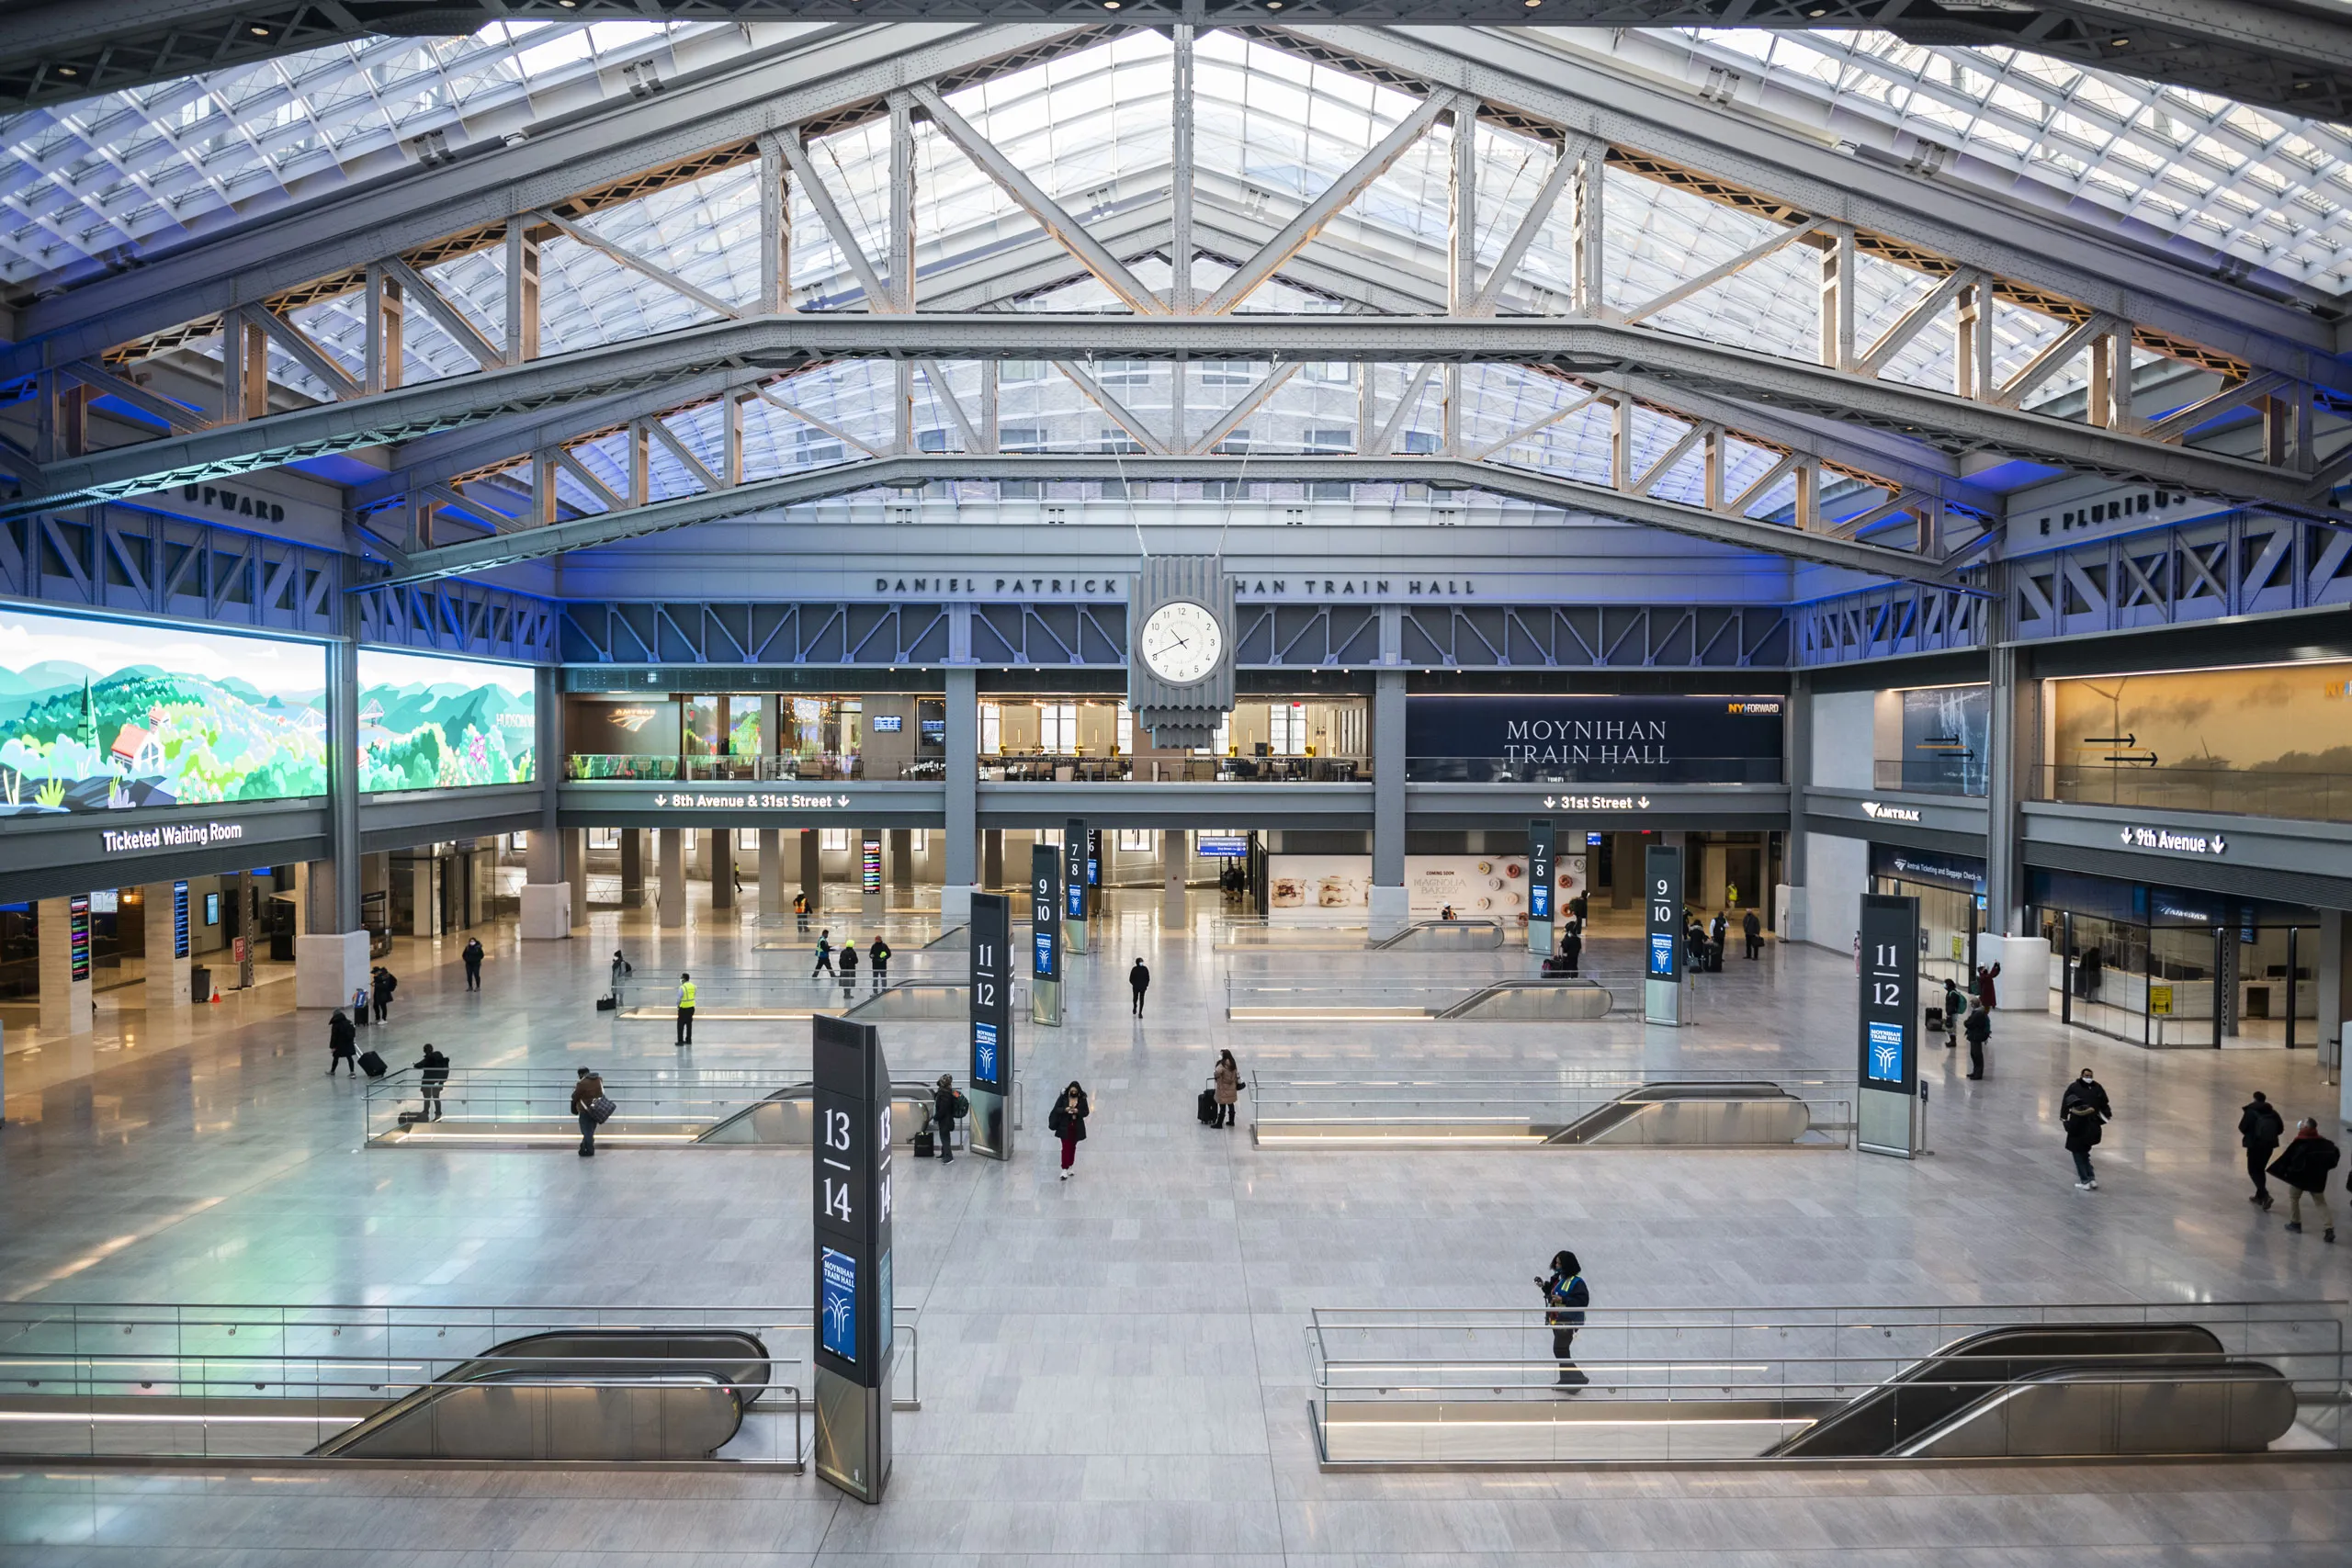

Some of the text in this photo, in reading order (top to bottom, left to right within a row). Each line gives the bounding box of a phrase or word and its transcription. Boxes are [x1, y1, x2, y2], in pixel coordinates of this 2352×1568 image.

[185, 483, 284, 522] UPWARD
[2040, 518, 2050, 535] E
[876, 579, 975, 592] DANIEL
[996, 579, 1115, 593] PATRICK
[1305, 581, 1389, 594] TRAIN
[1409, 581, 1474, 594] HALL
[1728, 704, 1779, 713] NY FORWARD
[1507, 720, 1666, 739] MOYNIHAN
[1504, 745, 1670, 764] TRAIN HALL
[673, 794, 831, 807] 8th Avenue & 31st Street
[1561, 796, 1632, 809] 31st Street
[1876, 808, 1919, 821] AMTRAK
[103, 823, 242, 852] Ticketed Waiting Room
[2137, 829, 2206, 852] 9th Avenue
[1072, 844, 1078, 855] 7
[1537, 845, 1544, 856] 7
[1072, 864, 1078, 876] 8
[1536, 865, 1544, 877] 8
[1921, 863, 1937, 875] Ticketing
[1946, 868, 1962, 879] Baggage
[1963, 871, 1982, 882] Check-in
[1039, 879, 1047, 894] 9
[1413, 879, 1466, 887] MAGNOLIA
[1657, 880, 1668, 895] 9
[1038, 906, 1050, 921] 10
[1654, 906, 1671, 922] 10
[978, 944, 992, 967] 11
[1876, 944, 1897, 967] 11
[977, 982, 994, 1006] 12
[1873, 982, 1900, 1006] 12
[824, 1108, 850, 1151] 13
[880, 1106, 891, 1151] 13
[823, 1178, 852, 1223] 14
[880, 1174, 891, 1223] 14
[824, 1260, 854, 1279] MOYNIHAN
[824, 1268, 840, 1282] TRAIN
[841, 1274, 855, 1288] HALL
